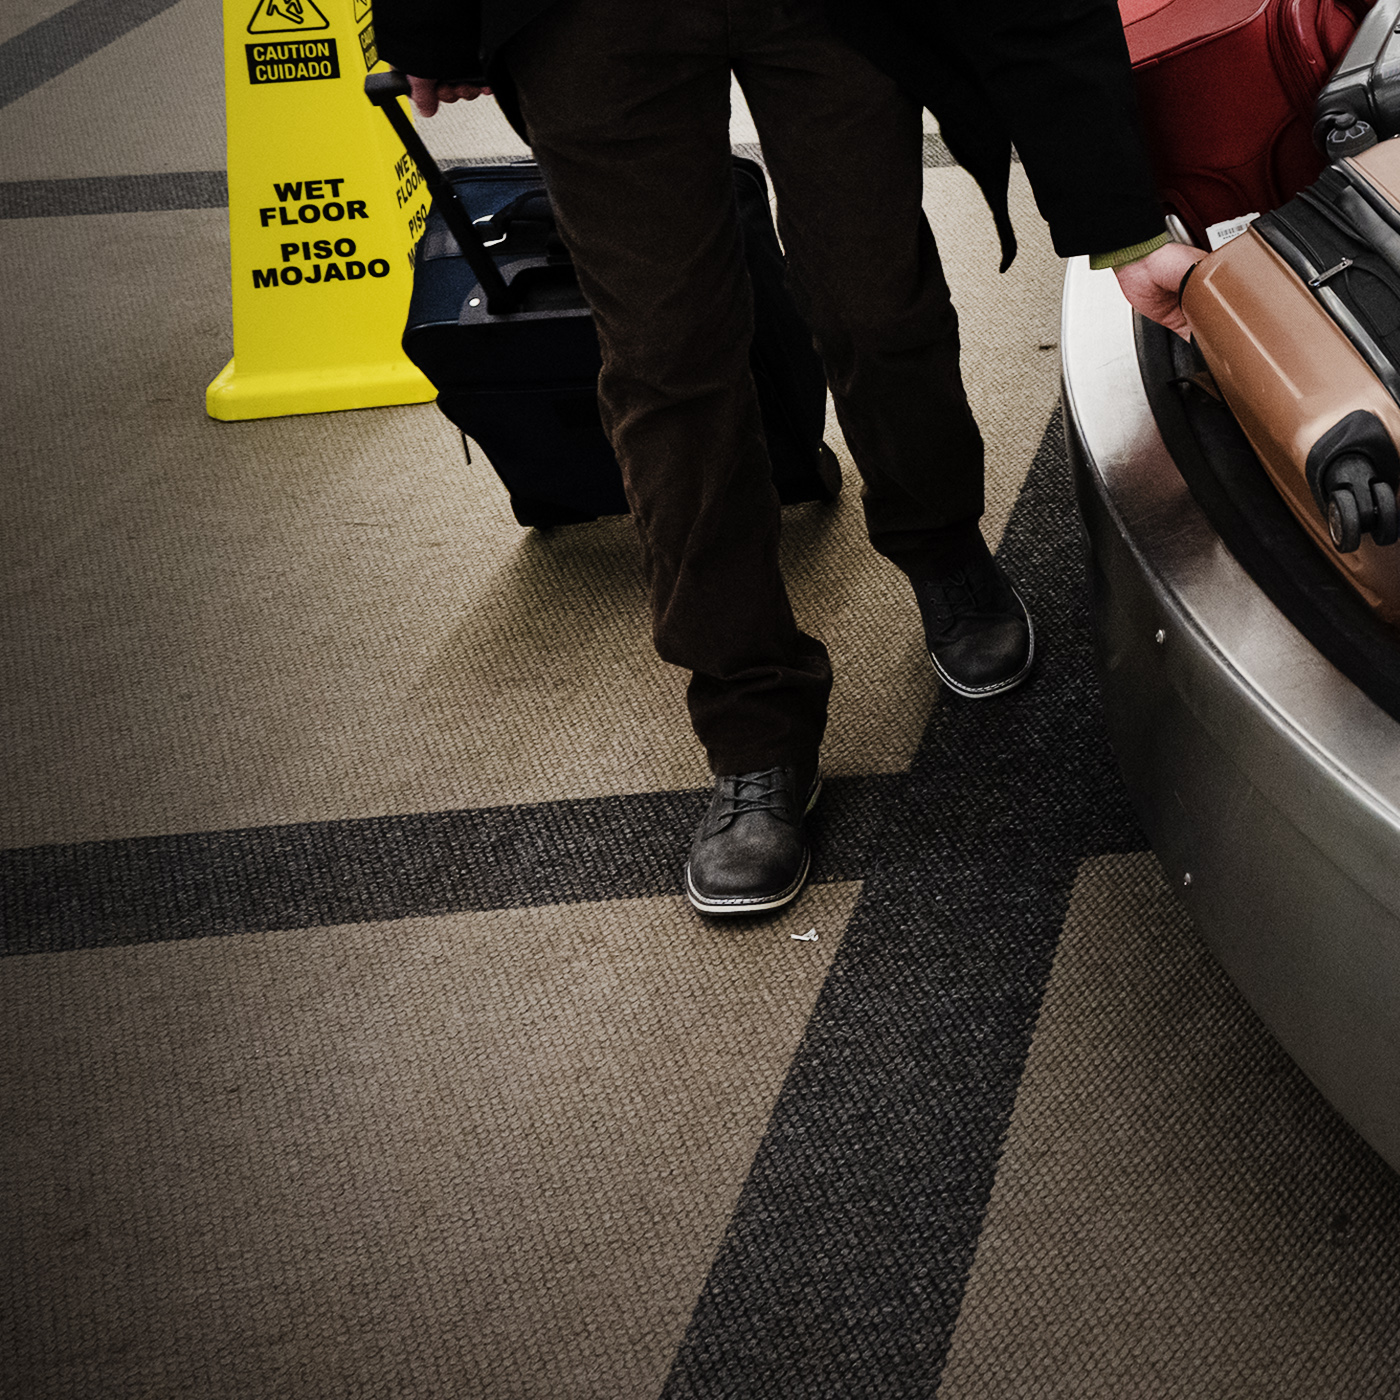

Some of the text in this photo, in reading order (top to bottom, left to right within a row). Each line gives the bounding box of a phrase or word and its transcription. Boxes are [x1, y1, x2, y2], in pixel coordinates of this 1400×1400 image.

[253, 43, 330, 62] CAUTION
[255, 60, 332, 81] CUIDADO
[273, 178, 345, 203] WET
[259, 200, 369, 227] FLOOR
[280, 238, 356, 262] PISO
[252, 258, 390, 289] MOJADO
